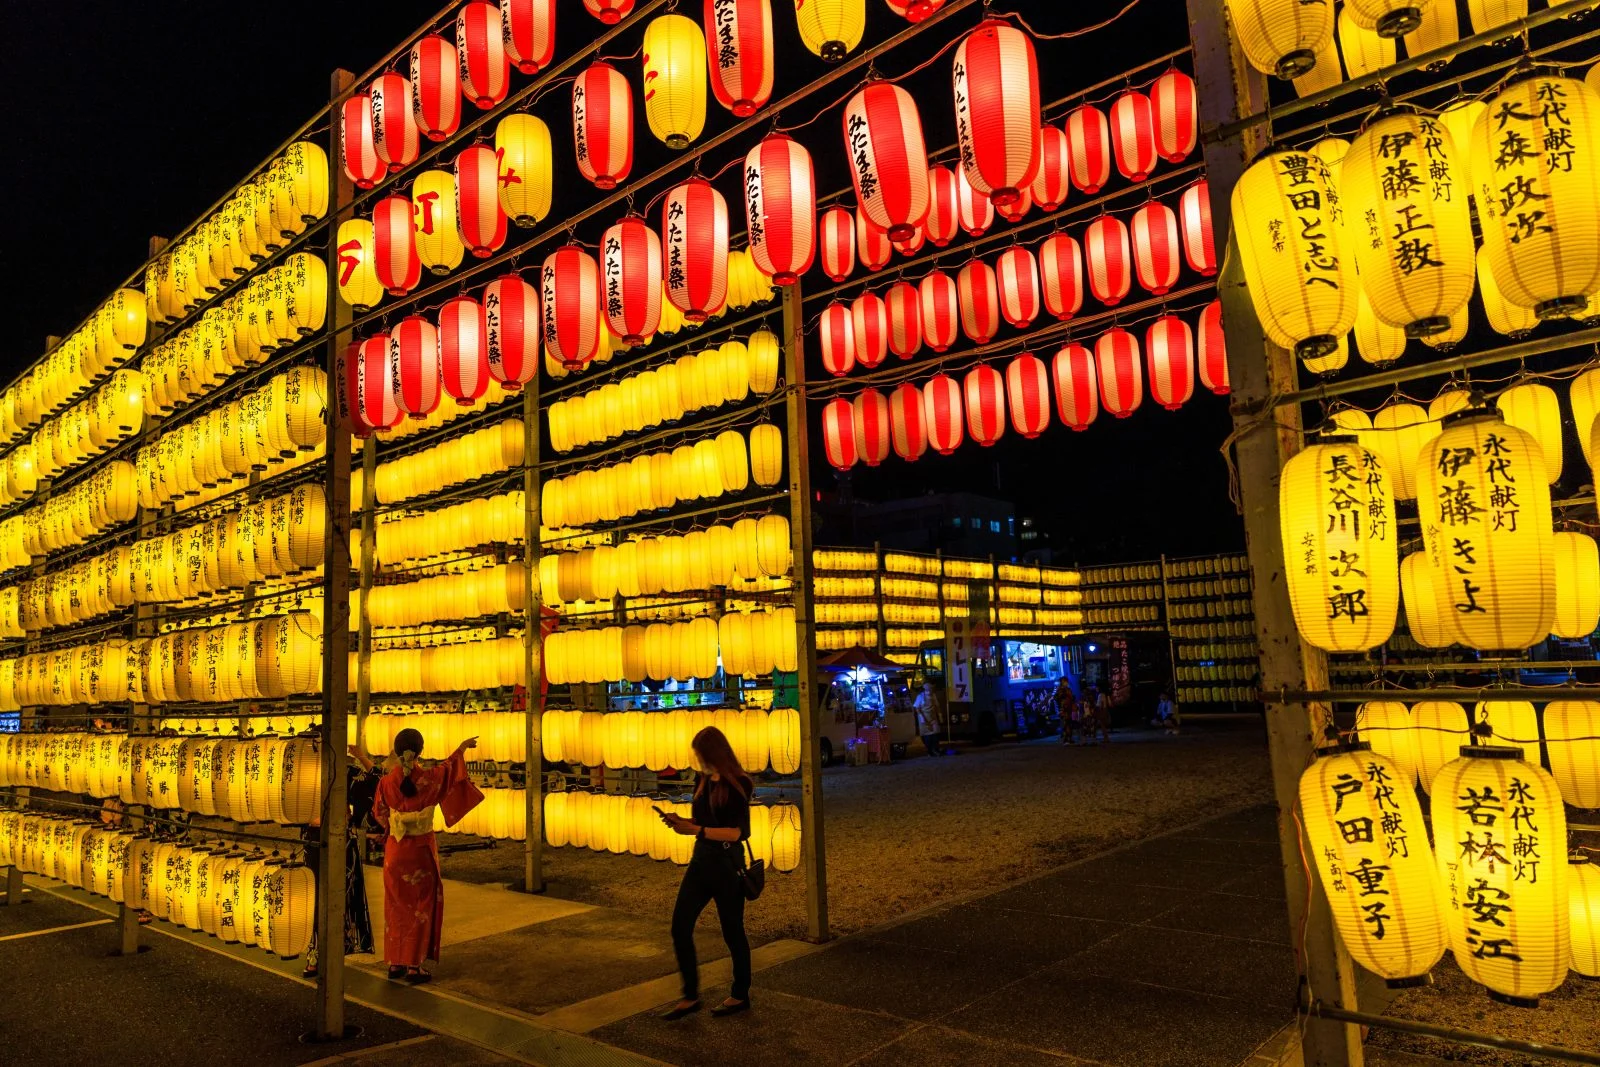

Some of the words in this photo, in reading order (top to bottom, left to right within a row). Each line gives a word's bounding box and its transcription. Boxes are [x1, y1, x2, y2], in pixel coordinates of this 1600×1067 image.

[371, 89, 385, 145] みたま祭
[573, 85, 587, 161] みたま祭
[953, 61, 975, 172] みたま祭
[1537, 82, 1576, 174] 永代献灯
[294, 143, 304, 175] 永代献灯
[849, 113, 877, 200] みたま祭
[1419, 119, 1452, 203] 永代献灯
[1494, 101, 1554, 244] 大森政次
[745, 166, 763, 246] みたま祭
[1376, 130, 1444, 275] 伊藤正教
[295, 254, 305, 288] 永代献灯
[668, 200, 685, 290] みたま祭
[274, 267, 283, 300] 永代献灯
[543, 265, 556, 342] みたま祭
[606, 237, 622, 318] みたま祭
[486, 293, 502, 365] みたま祭
[291, 369, 301, 405] 永代献灯
[390, 337, 401, 395] みたま祭
[295, 488, 306, 525] 永代献灯
[1362, 450, 1388, 542] 永代献灯
[1483, 433, 1521, 532] 永代献灯
[243, 508, 251, 542] 永代献灯
[257, 503, 266, 537] 永代献灯
[277, 497, 286, 532] 永代献灯
[1324, 454, 1369, 624] 長谷川次郎
[1438, 447, 1488, 614] 伊藤きよ
[191, 633, 199, 667] 永代献灯
[280, 617, 289, 654] 永代献灯
[170, 742, 179, 775] 永代献灯
[202, 744, 211, 779] 永代献灯
[228, 747, 236, 784] 永代献灯
[251, 744, 261, 781] 永代献灯
[267, 745, 276, 784] 永代献灯
[285, 742, 297, 782] 永代献灯
[1366, 762, 1409, 859] 永代献灯
[1507, 778, 1541, 884] 永代献灯
[183, 858, 192, 893] 永代献灯
[200, 861, 209, 898] 永代献灯
[1331, 774, 1392, 940] 戸田重子
[1455, 787, 1523, 963] 若林安江
[233, 868, 241, 907] 永代献灯
[274, 874, 285, 916] 永代献灯
